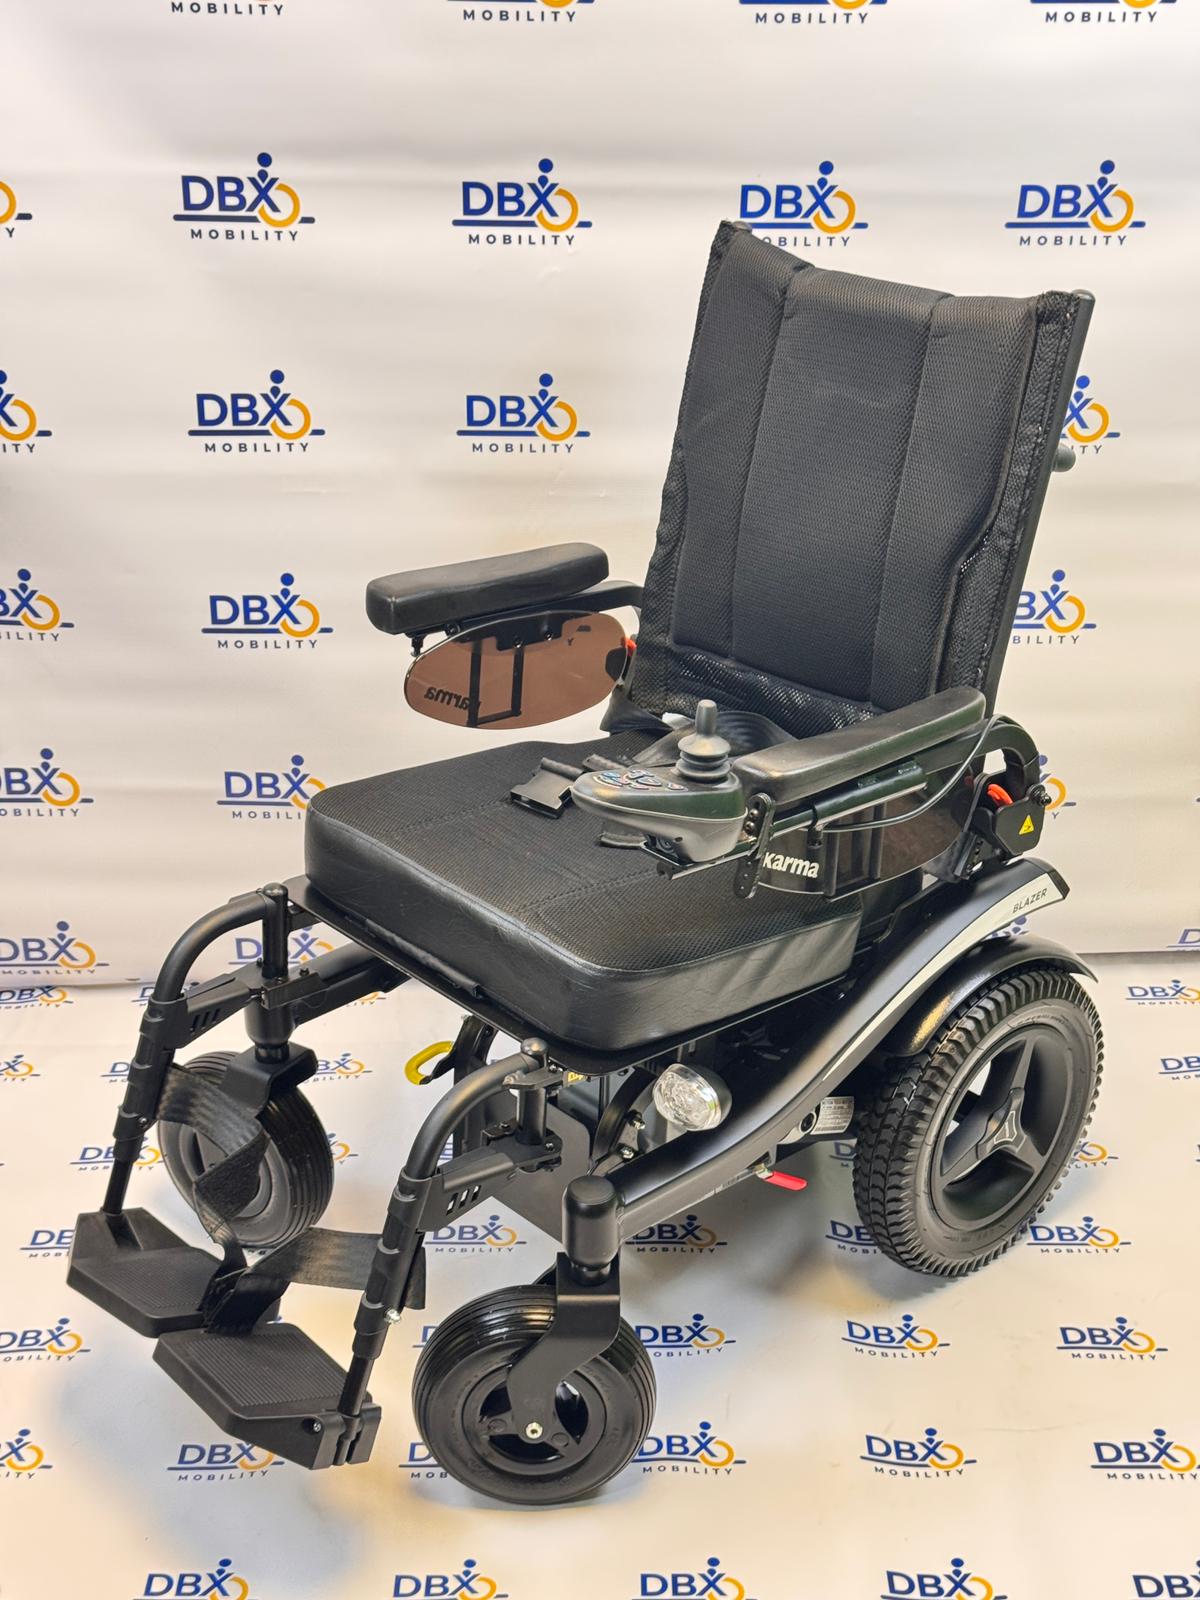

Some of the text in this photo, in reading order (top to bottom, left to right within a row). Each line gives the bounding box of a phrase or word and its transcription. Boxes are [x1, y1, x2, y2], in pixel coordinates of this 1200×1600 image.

[171, 2, 284, 16] MOBILITY
[463, 10, 576, 22] MOBILITY
[755, 12, 869, 24] MOBILITY
[1045, 11, 1157, 23] MOBILITY
[181, 175, 281, 213] DBX
[462, 181, 559, 218] DBX
[1017, 184, 1120, 219] DBX
[740, 184, 838, 220] DBX
[190, 228, 299, 242] MOBILITY
[468, 234, 575, 246] MOBILITY
[762, 236, 851, 248] OBILITY
[1019, 235, 1128, 247] MOBILITY
[196, 393, 292, 427] DBX
[466, 395, 559, 428] DBX
[204, 442, 309, 454] MOBILITY
[472, 443, 574, 454] MOBILITY
[209, 594, 301, 626] DBX
[1015, 590, 1069, 620] BX
[217, 639, 318, 650] MOBILITY
[1012, 635, 1080, 645] BILITY
[0, 767, 61, 796] BX
[224, 771, 311, 800] DBX
[0, 808, 80, 818] OBILITY
[232, 810, 302, 820] MOBILI
[1012, 888, 1047, 913] BLAZER
[1127, 985, 1190, 998] DBX
[316, 1059, 353, 1071] BX
[1160, 1055, 1200, 1072] DB
[1029, 1225, 1105, 1242] DBX
[636, 1246, 716, 1254] MOBILITY
[633, 1324, 709, 1344] DBX
[846, 1320, 923, 1344] DBX
[1058, 1326, 1141, 1347] DBX
[2, 1354, 76, 1362] OBILITY
[653, 1347, 724, 1358] OBILITY
[855, 1347, 939, 1359] MOBILITY
[1071, 1352, 1157, 1361] MOBILITY
[177, 1443, 255, 1466] DBX
[637, 1435, 718, 1460] DBX
[865, 1434, 944, 1463] DBX
[1093, 1440, 1180, 1464] DBX
[177, 1469, 269, 1481] MOBILITY
[642, 1466, 733, 1476] MOBILITY
[874, 1466, 965, 1479] MOBILITY
[1106, 1472, 1199, 1481] MOBILITY
[143, 1572, 236, 1598] DBX
[392, 1573, 482, 1599] DBX
[640, 1572, 727, 1599] DBX
[885, 1570, 973, 1599] DBX
[1132, 1574, 1200, 1600] DB
